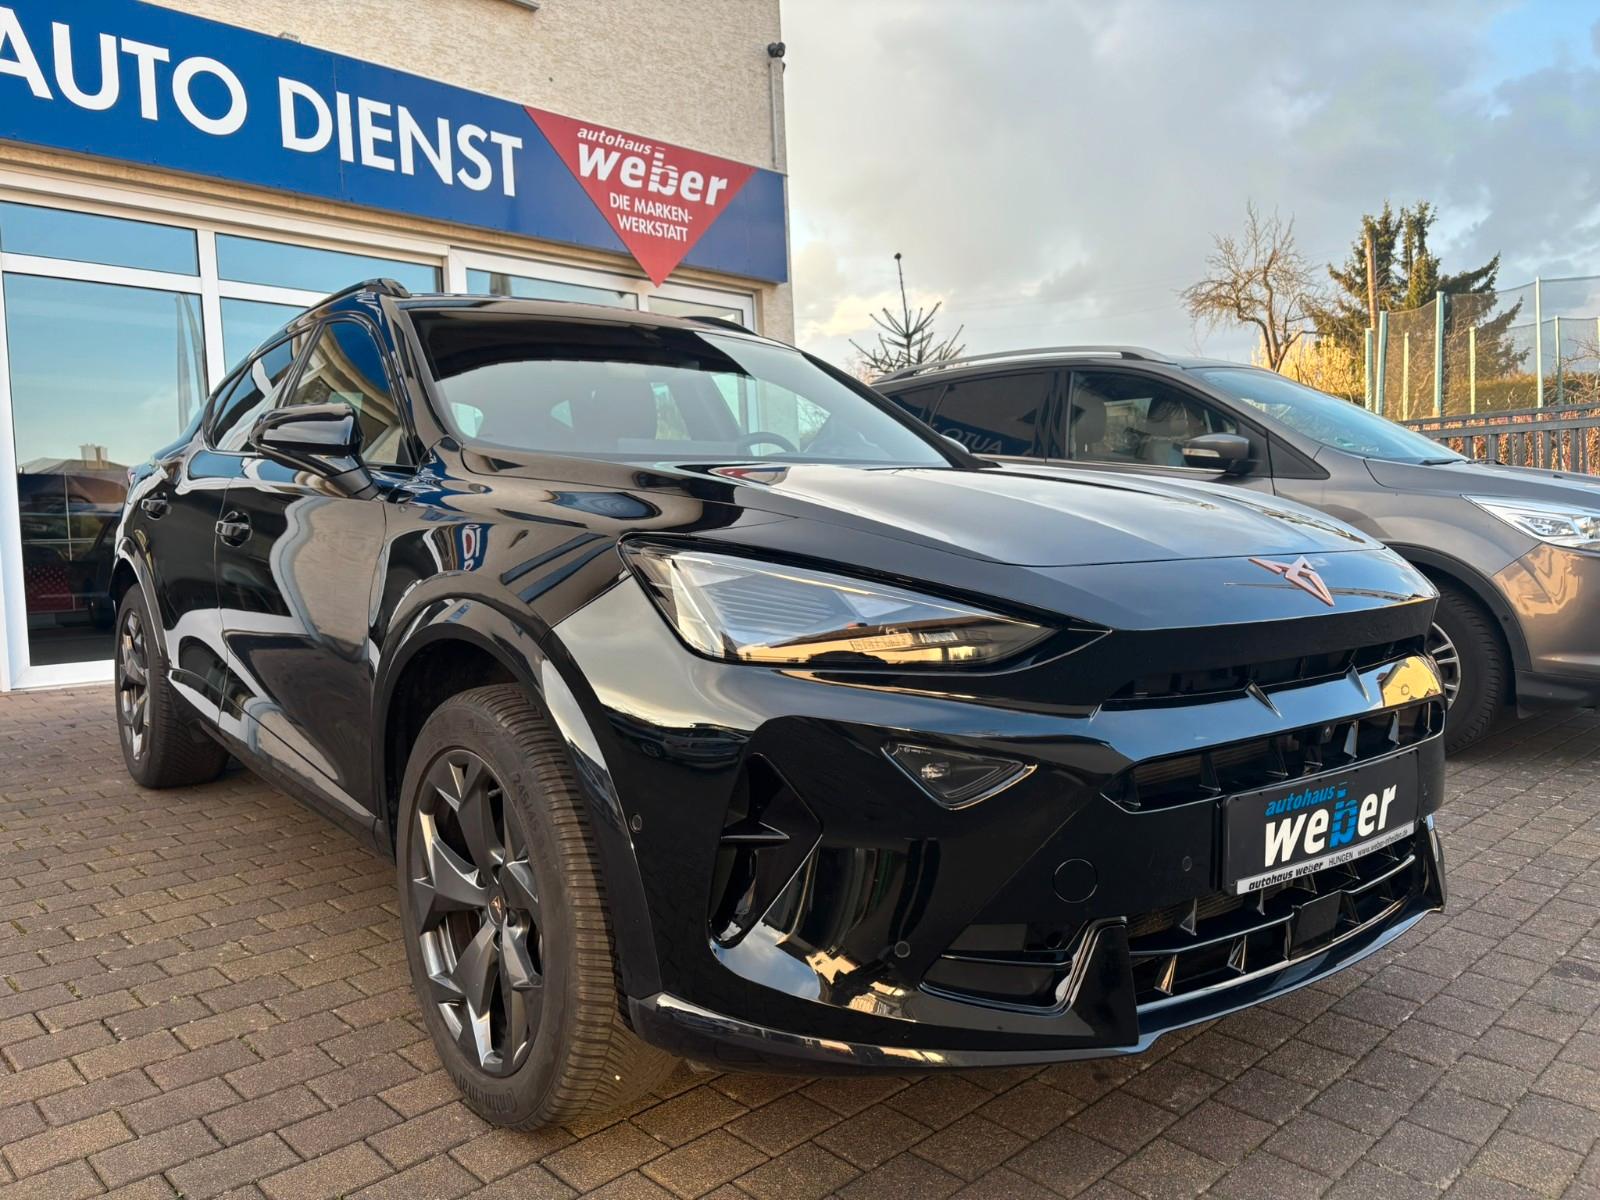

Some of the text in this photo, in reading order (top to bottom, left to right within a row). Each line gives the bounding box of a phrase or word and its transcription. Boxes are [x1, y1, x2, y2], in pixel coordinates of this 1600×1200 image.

[0, 7, 523, 197] AUTO DIENST
[577, 128, 652, 154] autohaus
[579, 146, 728, 206] weber
[609, 192, 693, 223] DIE MARKEN-
[616, 213, 689, 242] WERKSTATT
[1265, 786, 1335, 817] autohaus
[1264, 782, 1397, 868] weber
[1248, 870, 1293, 890] autohaus
[1295, 861, 1324, 876] weber
[1328, 850, 1354, 866] HUNGEN
